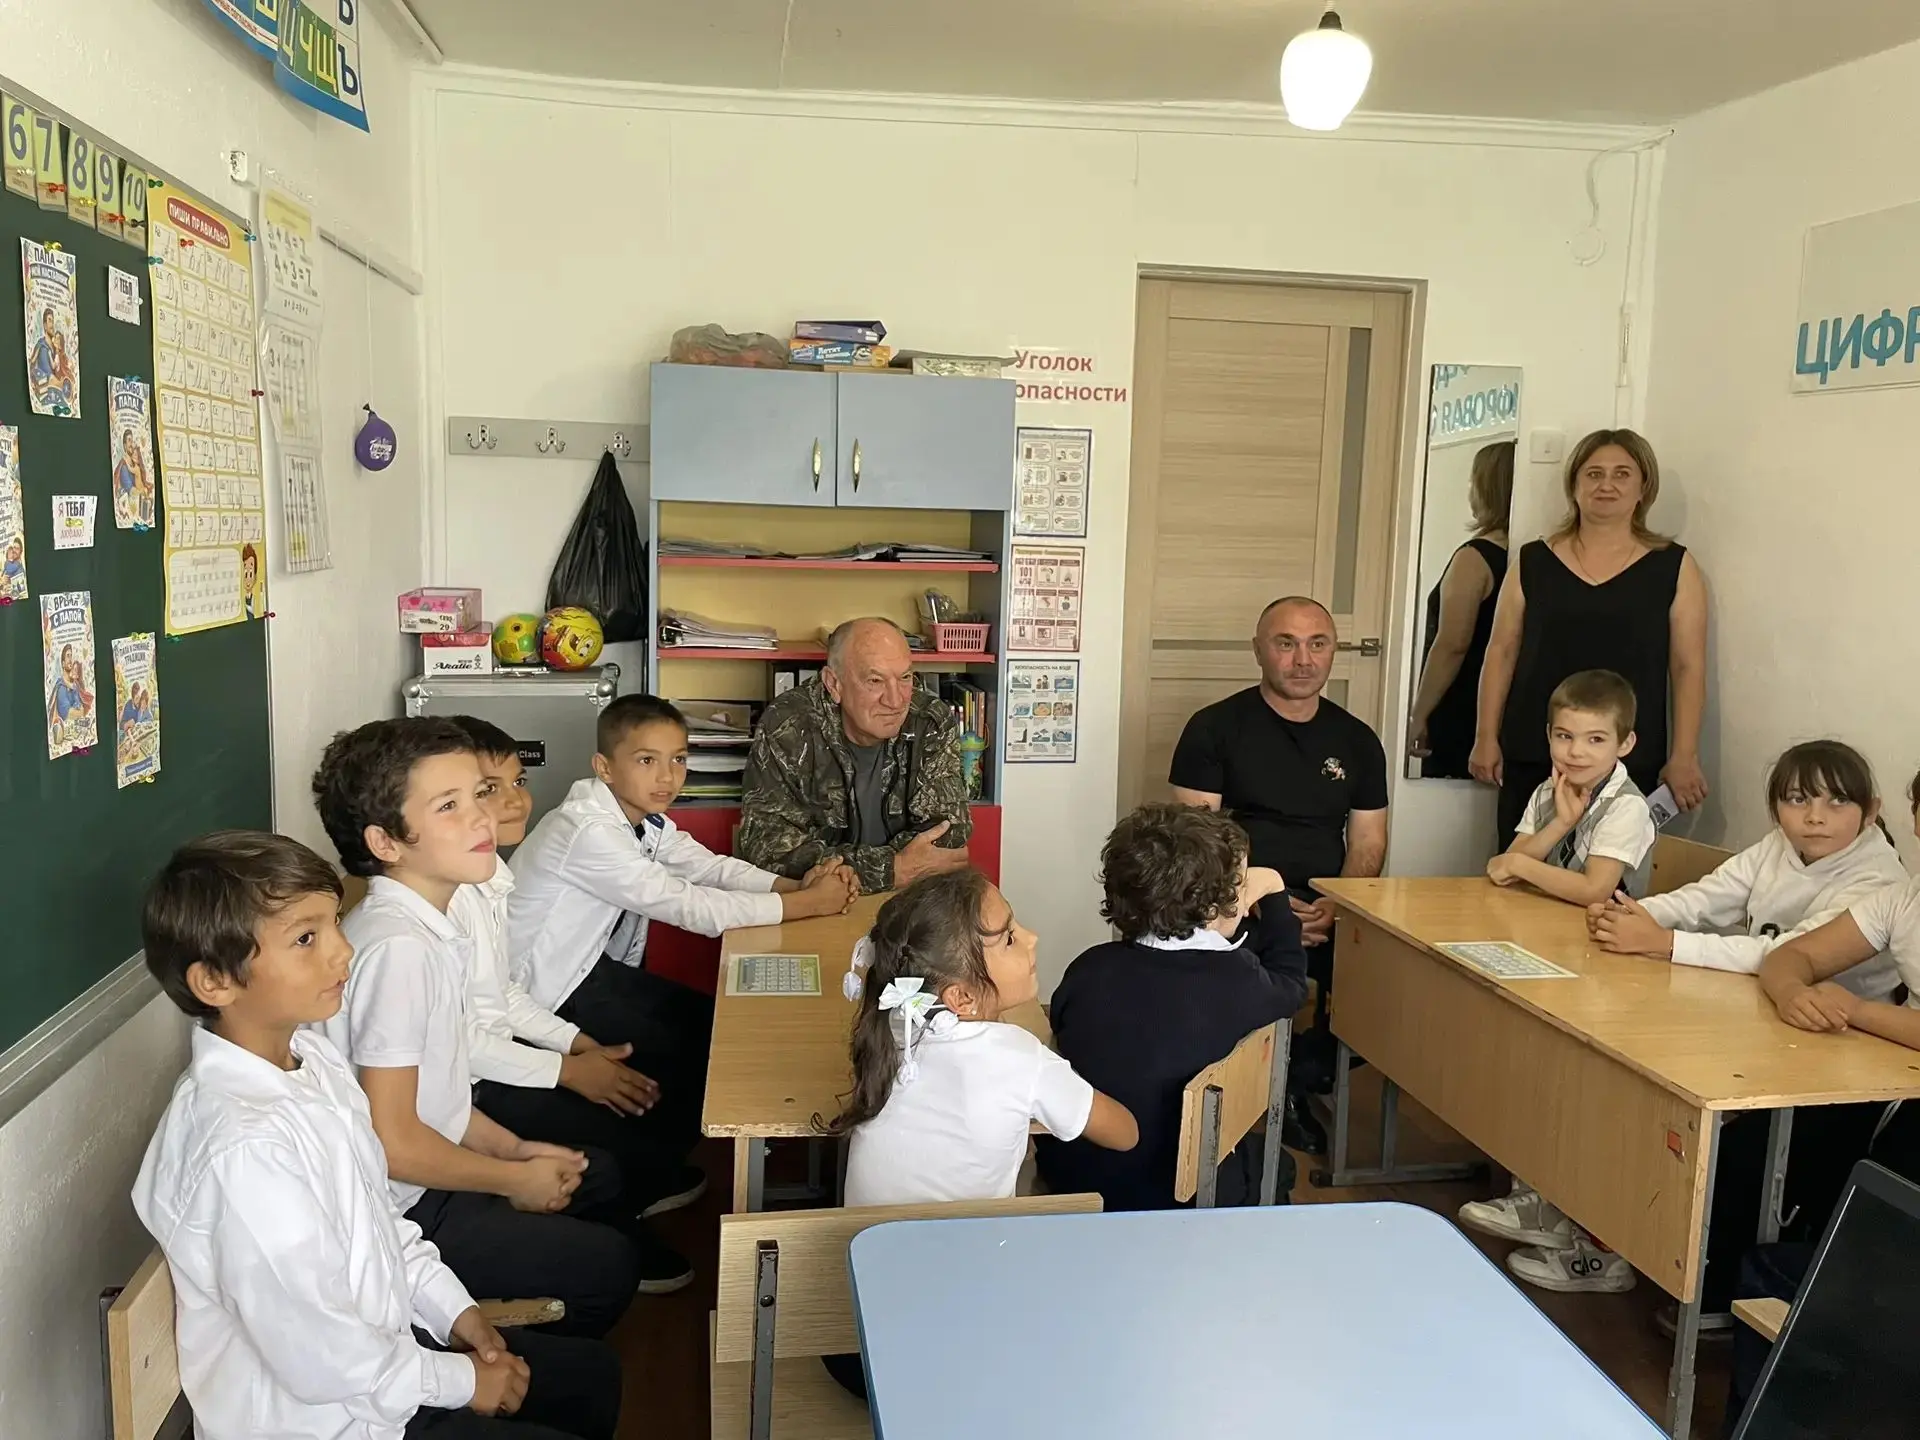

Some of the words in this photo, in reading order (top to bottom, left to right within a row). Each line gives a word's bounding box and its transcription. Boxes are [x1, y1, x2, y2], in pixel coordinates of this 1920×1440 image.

[9, 104, 27, 161] 6
[36, 117, 53, 172] 7
[72, 136, 88, 191] 8
[99, 153, 114, 203] 9
[124, 172, 144, 211] 10
[1014, 350, 1093, 372] Уголок
[66, 501, 85, 517] ТЕБЯ
[519, 750, 541, 759] Class
